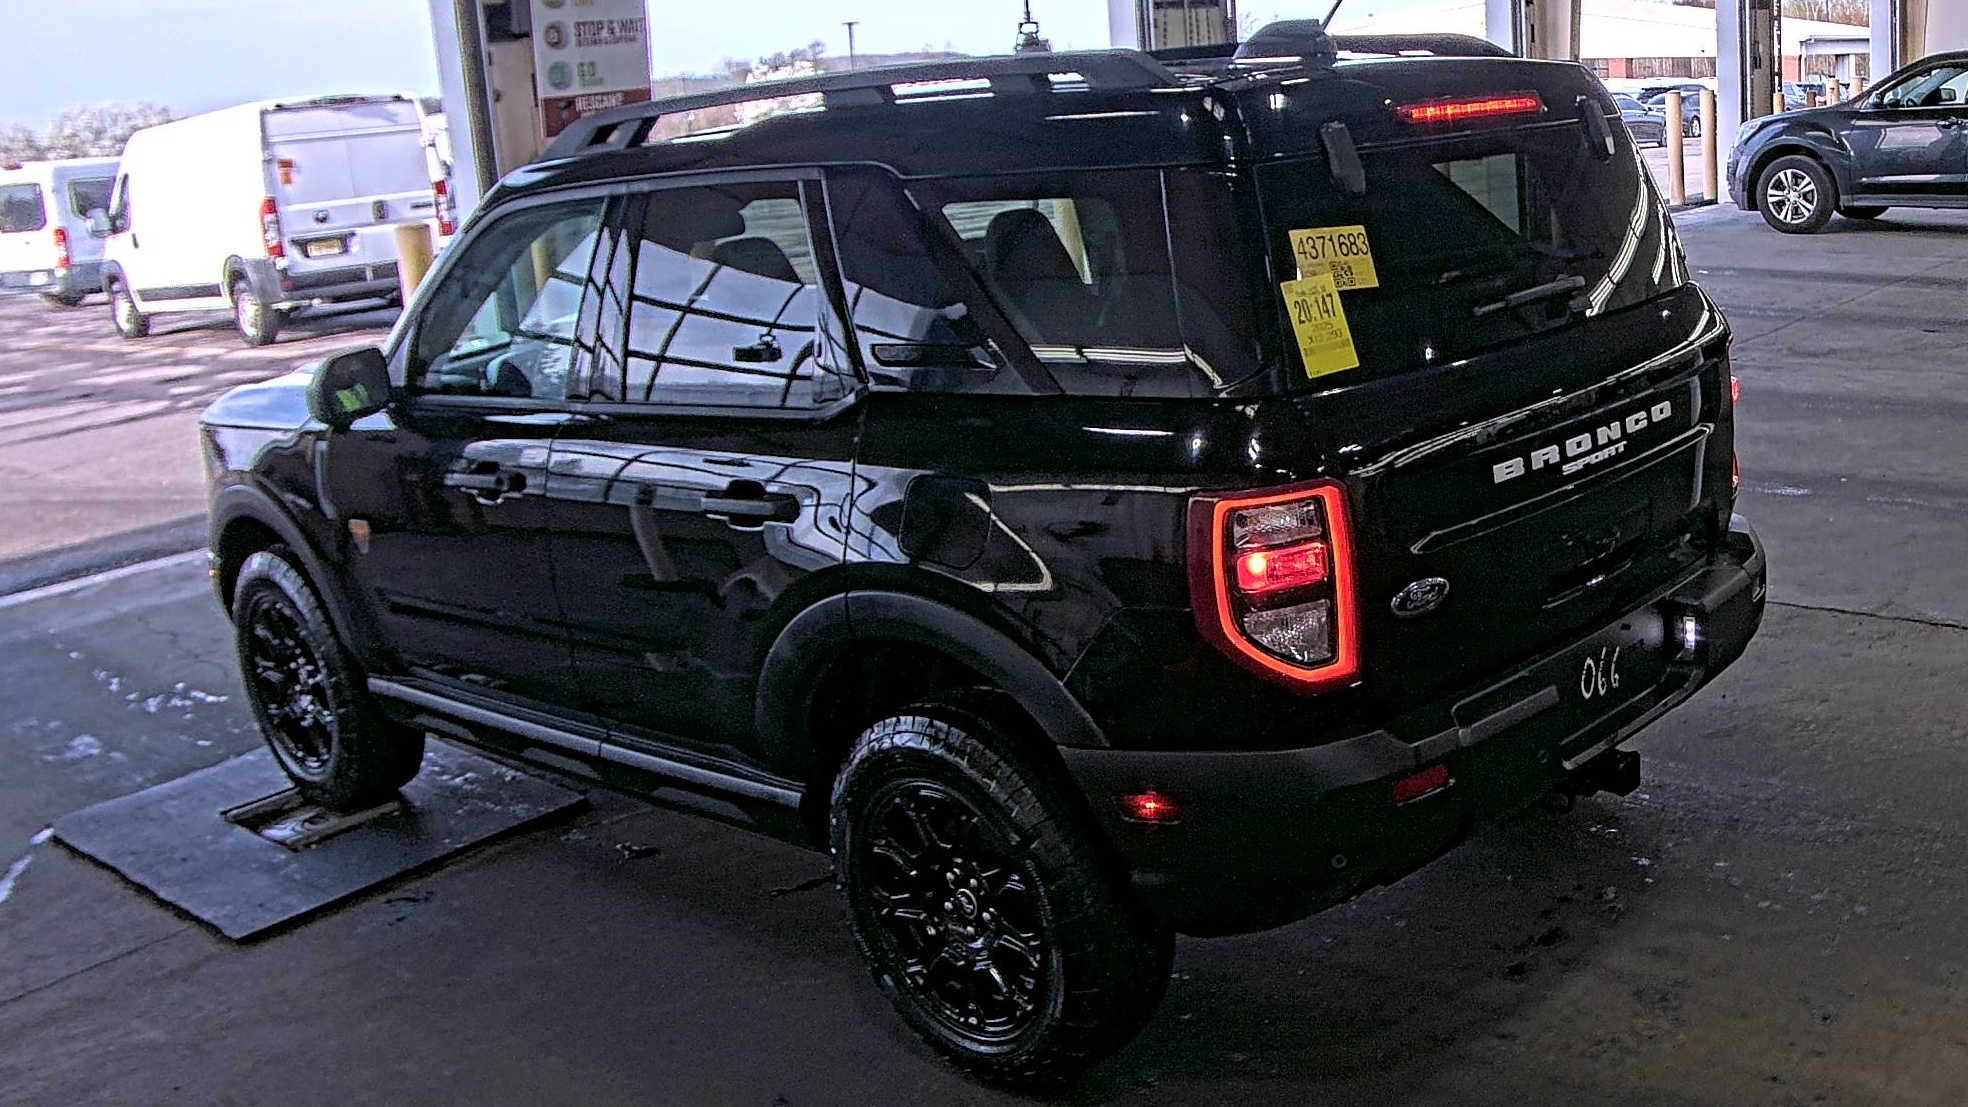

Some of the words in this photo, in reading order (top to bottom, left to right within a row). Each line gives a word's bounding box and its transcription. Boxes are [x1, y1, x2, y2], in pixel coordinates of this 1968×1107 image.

[574, 20, 604, 37] STOP
[619, 17, 645, 35] WAIT
[1297, 232, 1369, 260] 4371683
[1492, 400, 1672, 484] BRONCO
[1561, 440, 1628, 476] SPORT
[1581, 646, 1620, 700] 066
